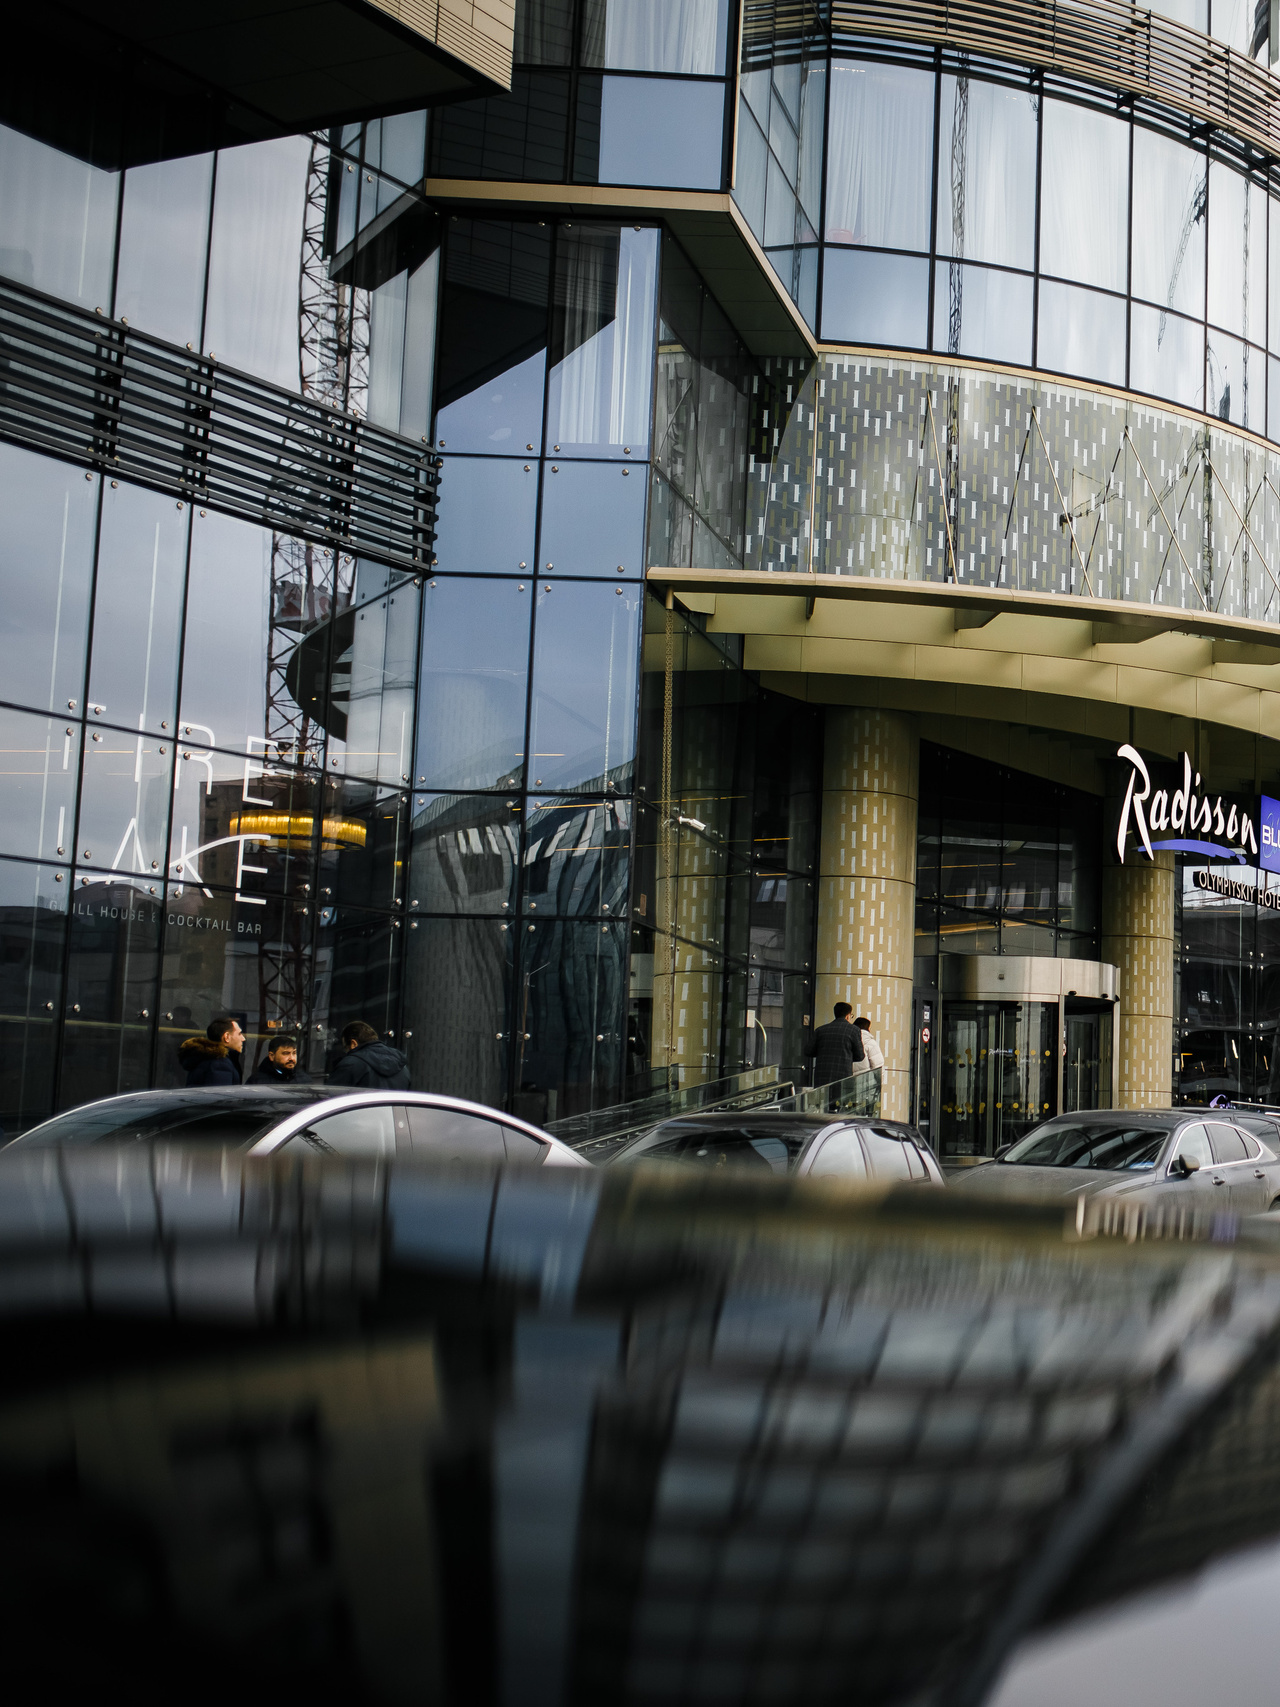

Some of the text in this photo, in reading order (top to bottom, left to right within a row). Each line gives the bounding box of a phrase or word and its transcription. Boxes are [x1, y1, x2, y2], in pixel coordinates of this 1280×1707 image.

[1117, 743, 1258, 864] Radisson
[1199, 871, 1255, 903] OLYMPIYSKIY
[49, 900, 93, 916] GILL
[100, 906, 145, 922] HOUSE
[167, 914, 231, 932] COCKTAIL
[237, 922, 262, 935] BAR
